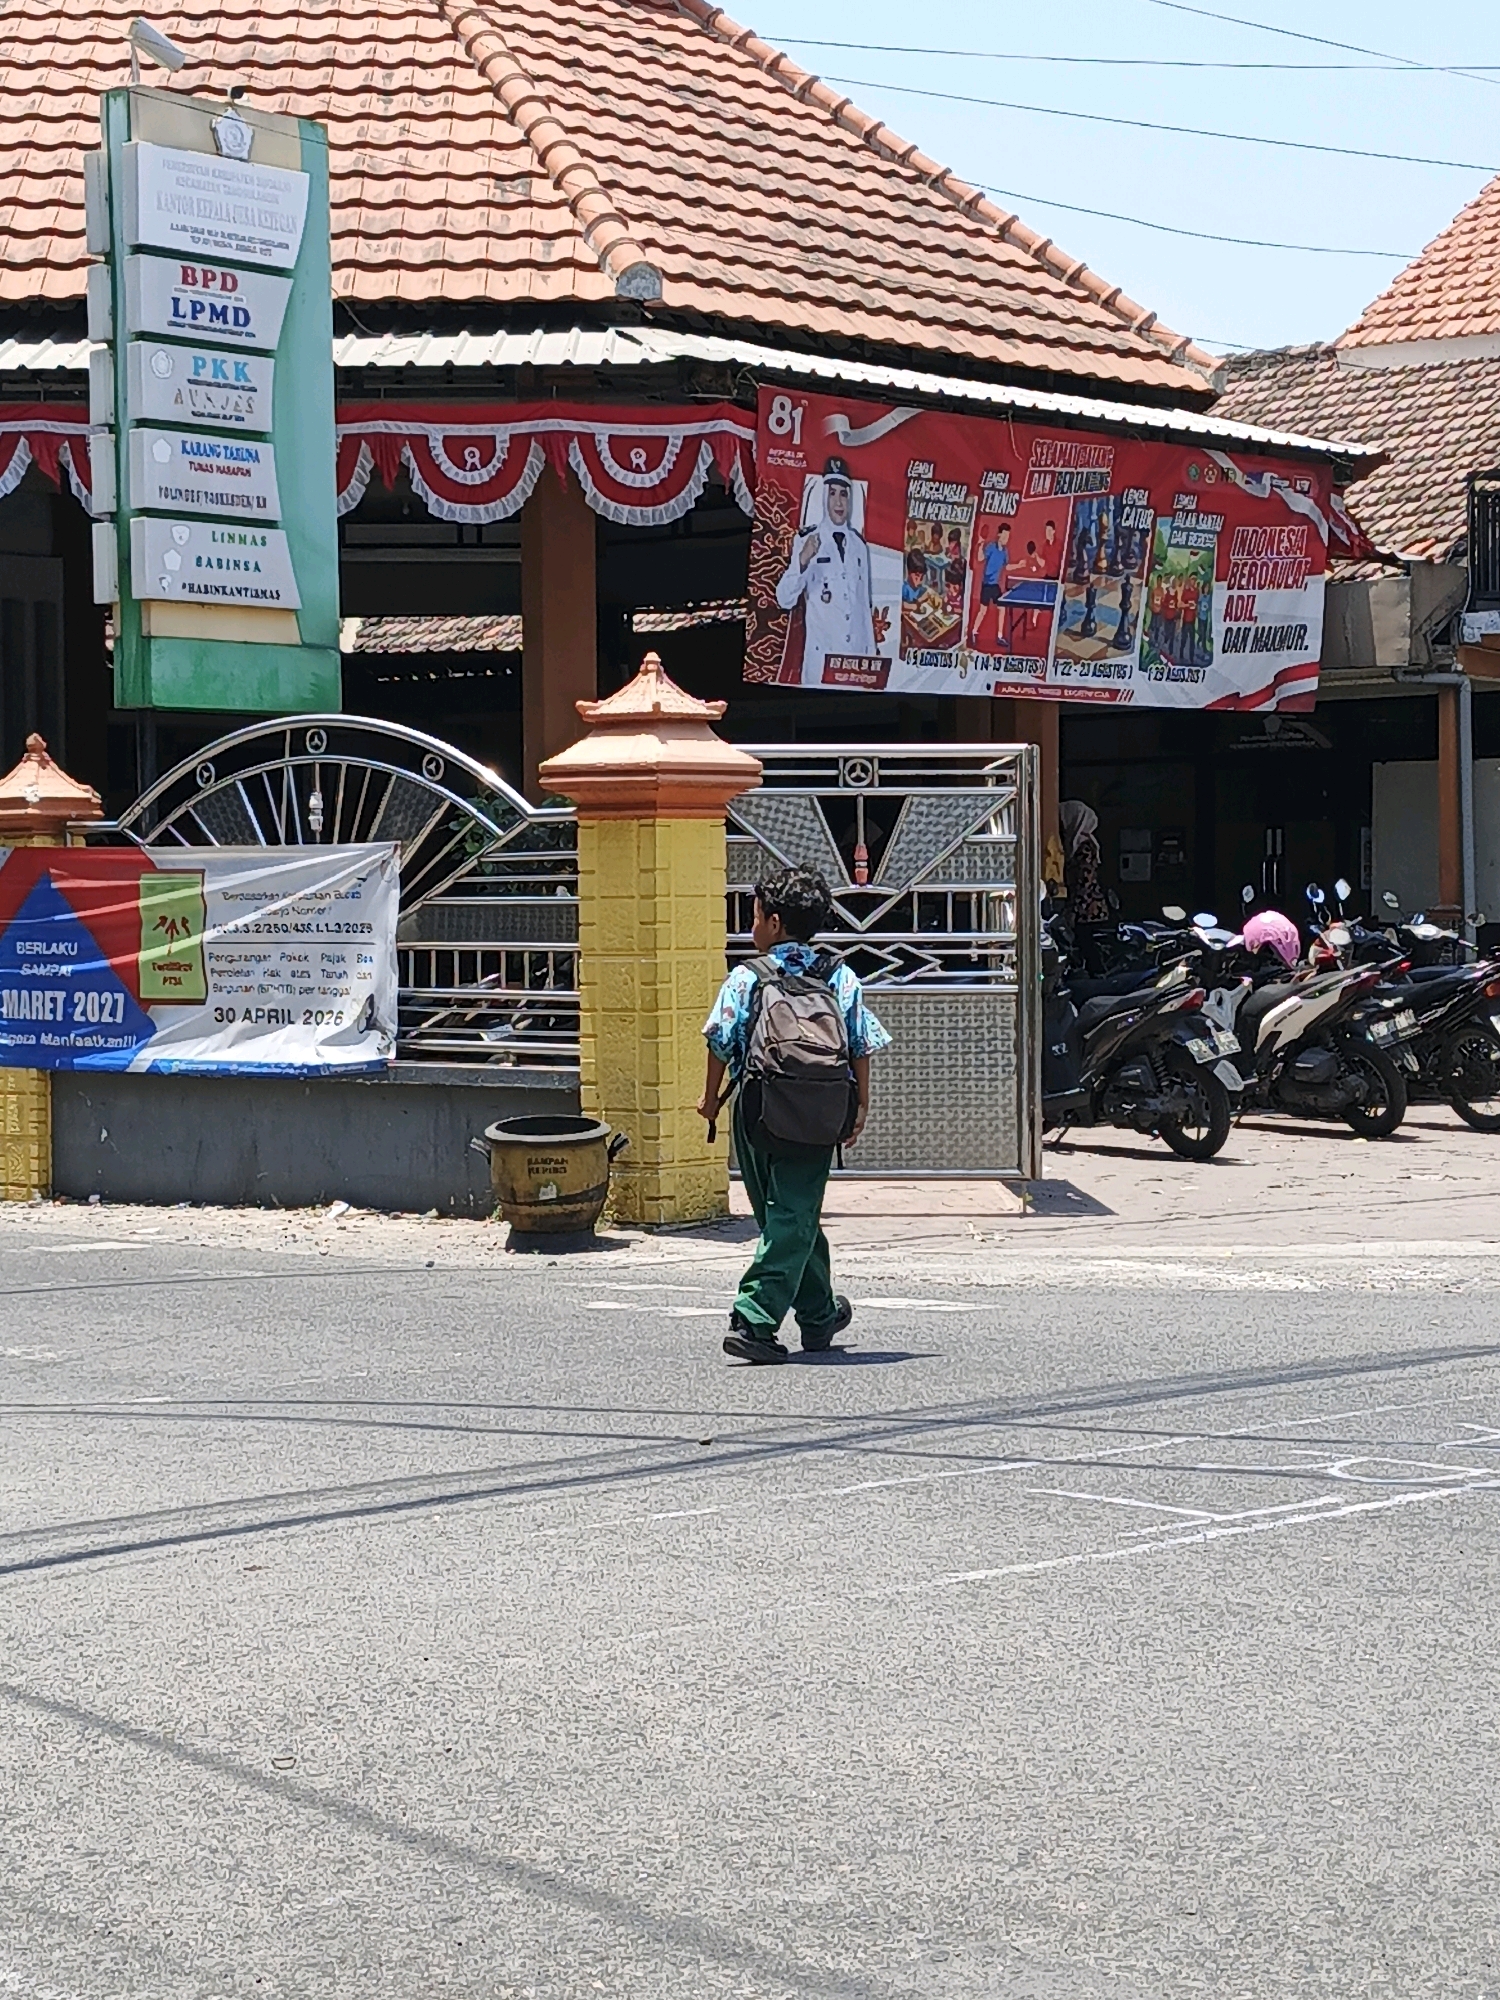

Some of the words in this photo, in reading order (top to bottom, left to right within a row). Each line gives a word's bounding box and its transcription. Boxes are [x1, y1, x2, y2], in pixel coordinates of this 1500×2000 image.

[180, 265, 239, 293] BPD
[171, 296, 251, 328] LPMD
[192, 355, 252, 383] PKK
[767, 394, 804, 445] 81
[1029, 472, 1052, 495] DAN
[980, 489, 1020, 516] TENNIS
[1121, 505, 1155, 530] CATUR
[211, 530, 268, 547] LINMAS
[1230, 525, 1308, 560] INDONESIA
[1221, 626, 1252, 655] DAN
[16, 941, 78, 956] BERLAKU
[20, 961, 72, 978] SAMPAI
[298, 985, 316, 997] per
[2, 989, 67, 1021] MARET
[213, 1005, 236, 1024] 30
[241, 1007, 296, 1025] APRIL
[301, 1008, 344, 1027] 2026
